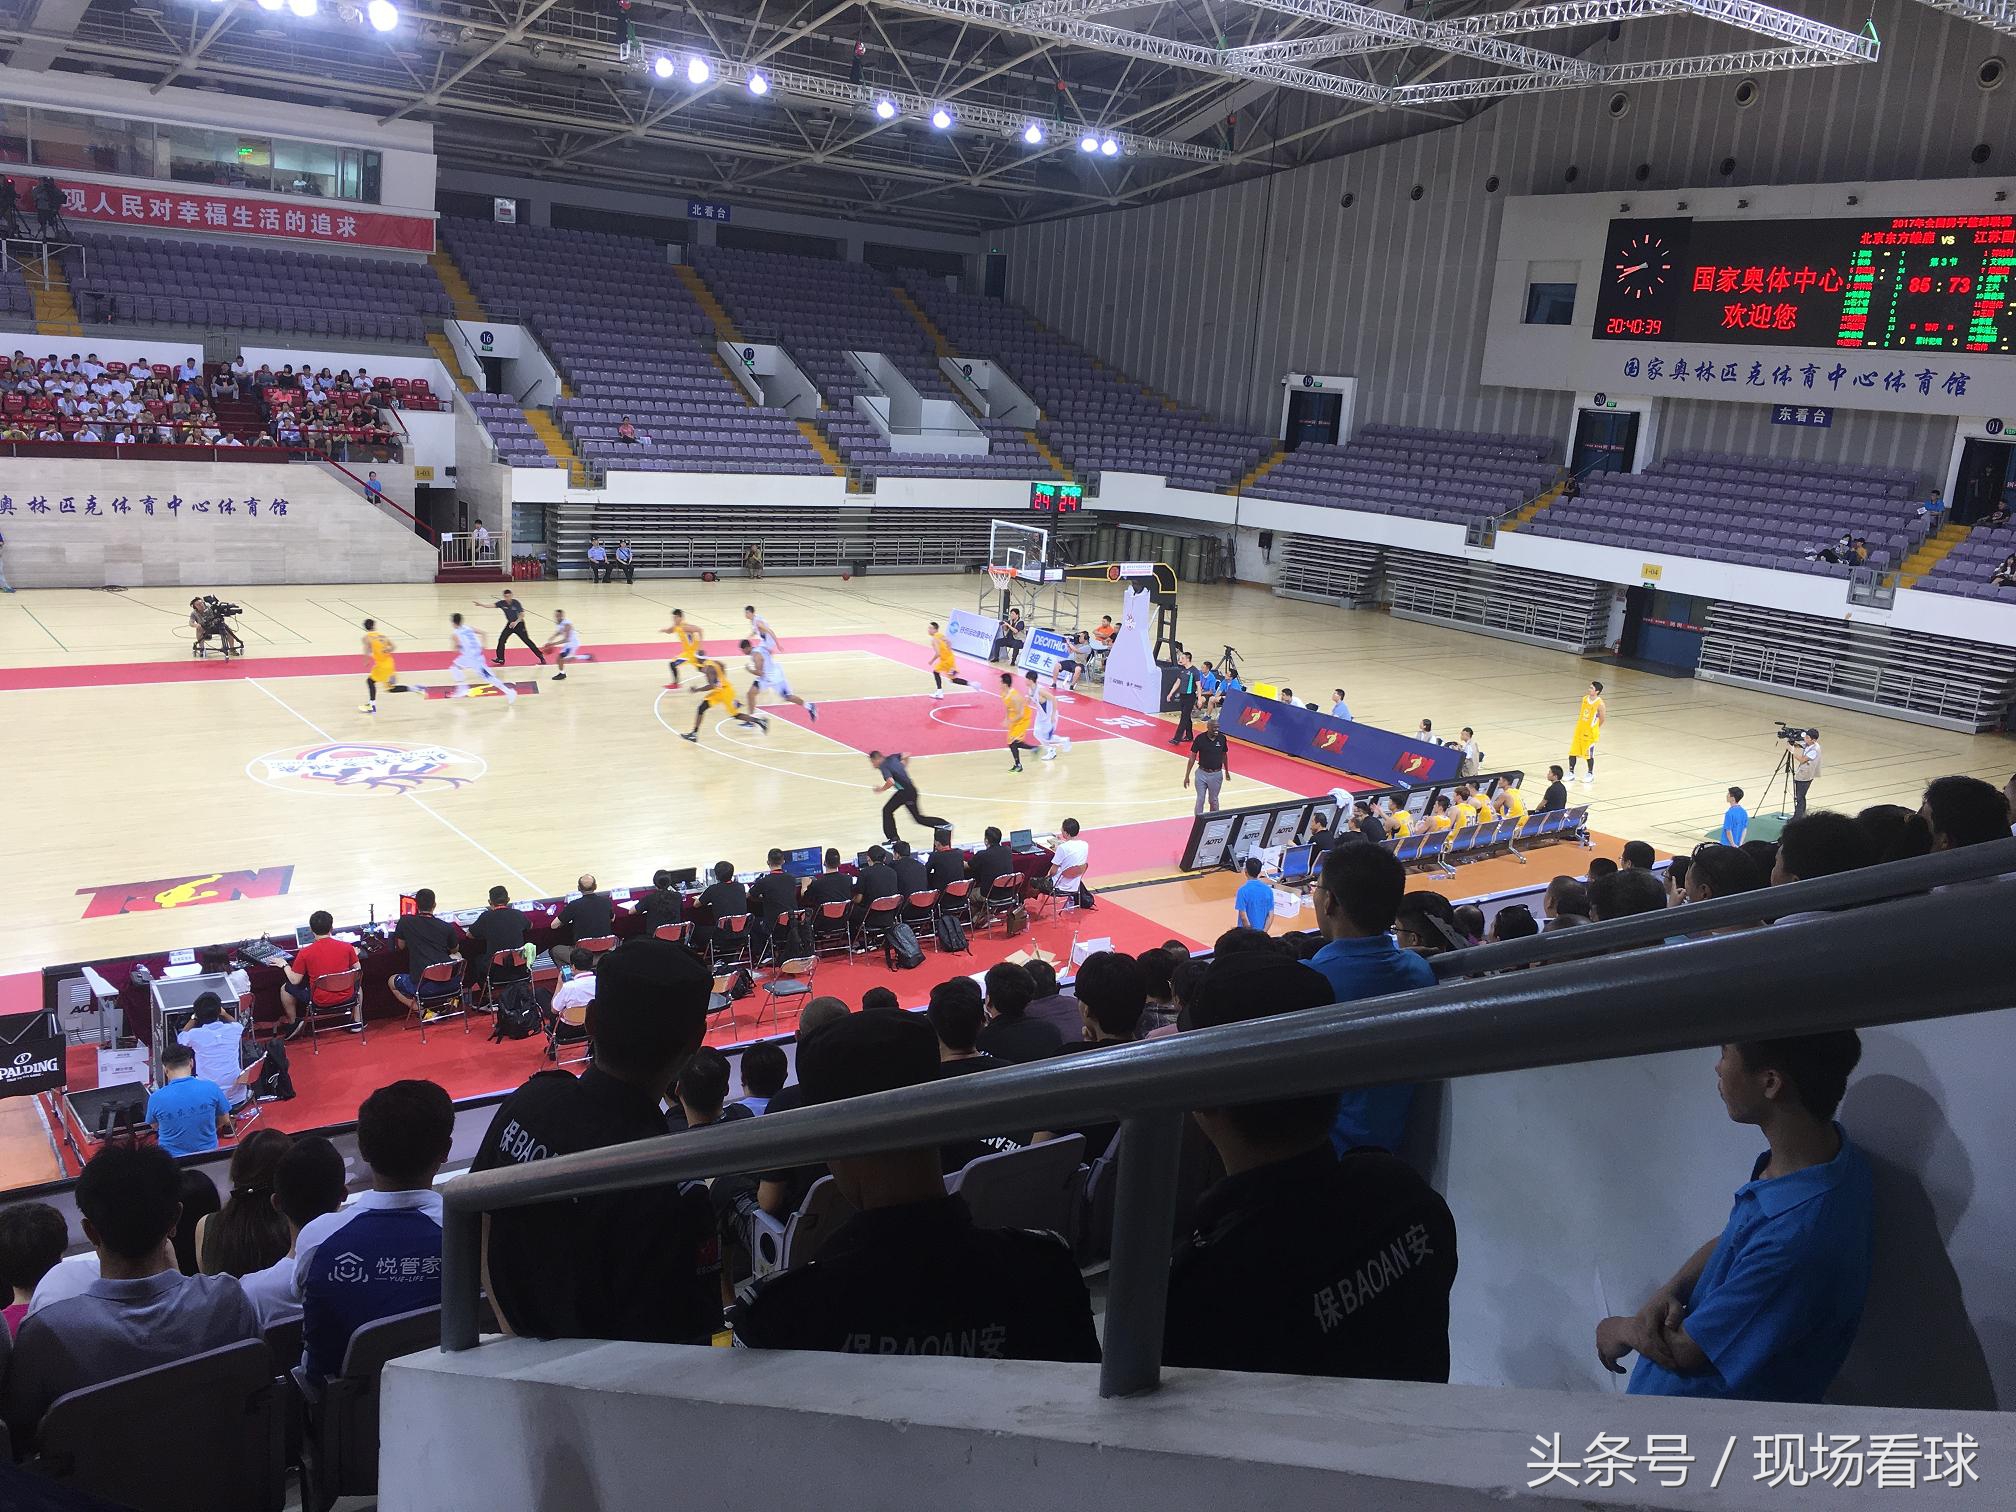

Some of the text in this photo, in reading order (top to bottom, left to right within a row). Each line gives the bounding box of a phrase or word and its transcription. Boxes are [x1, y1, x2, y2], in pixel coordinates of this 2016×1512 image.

[62, 188, 358, 238] 现人民对幸福生活的追求
[692, 203, 725, 219] 北看台
[1941, 235, 1956, 245] VS
[1973, 230, 2016, 244] 江苏国
[1692, 265, 1844, 295] 国家奥体中心
[1908, 277, 1931, 294] 85
[1949, 277, 1972, 294] 73
[1723, 303, 1799, 332] 欢迎您
[1606, 318, 1663, 336] 20:40:39
[483, 333, 491, 343] 16
[1623, 357, 1972, 397] 国家奥林匹克体育中心体育馆
[1779, 407, 1826, 424] 东看台
[0, 494, 289, 517] 奥林匹克体育中心体育馆
[1034, 493, 1050, 509] 24
[1058, 496, 1076, 512] 24
[376, 1256, 441, 1275] 悦管家
[1314, 1224, 1434, 1334] 保BAOAN安
